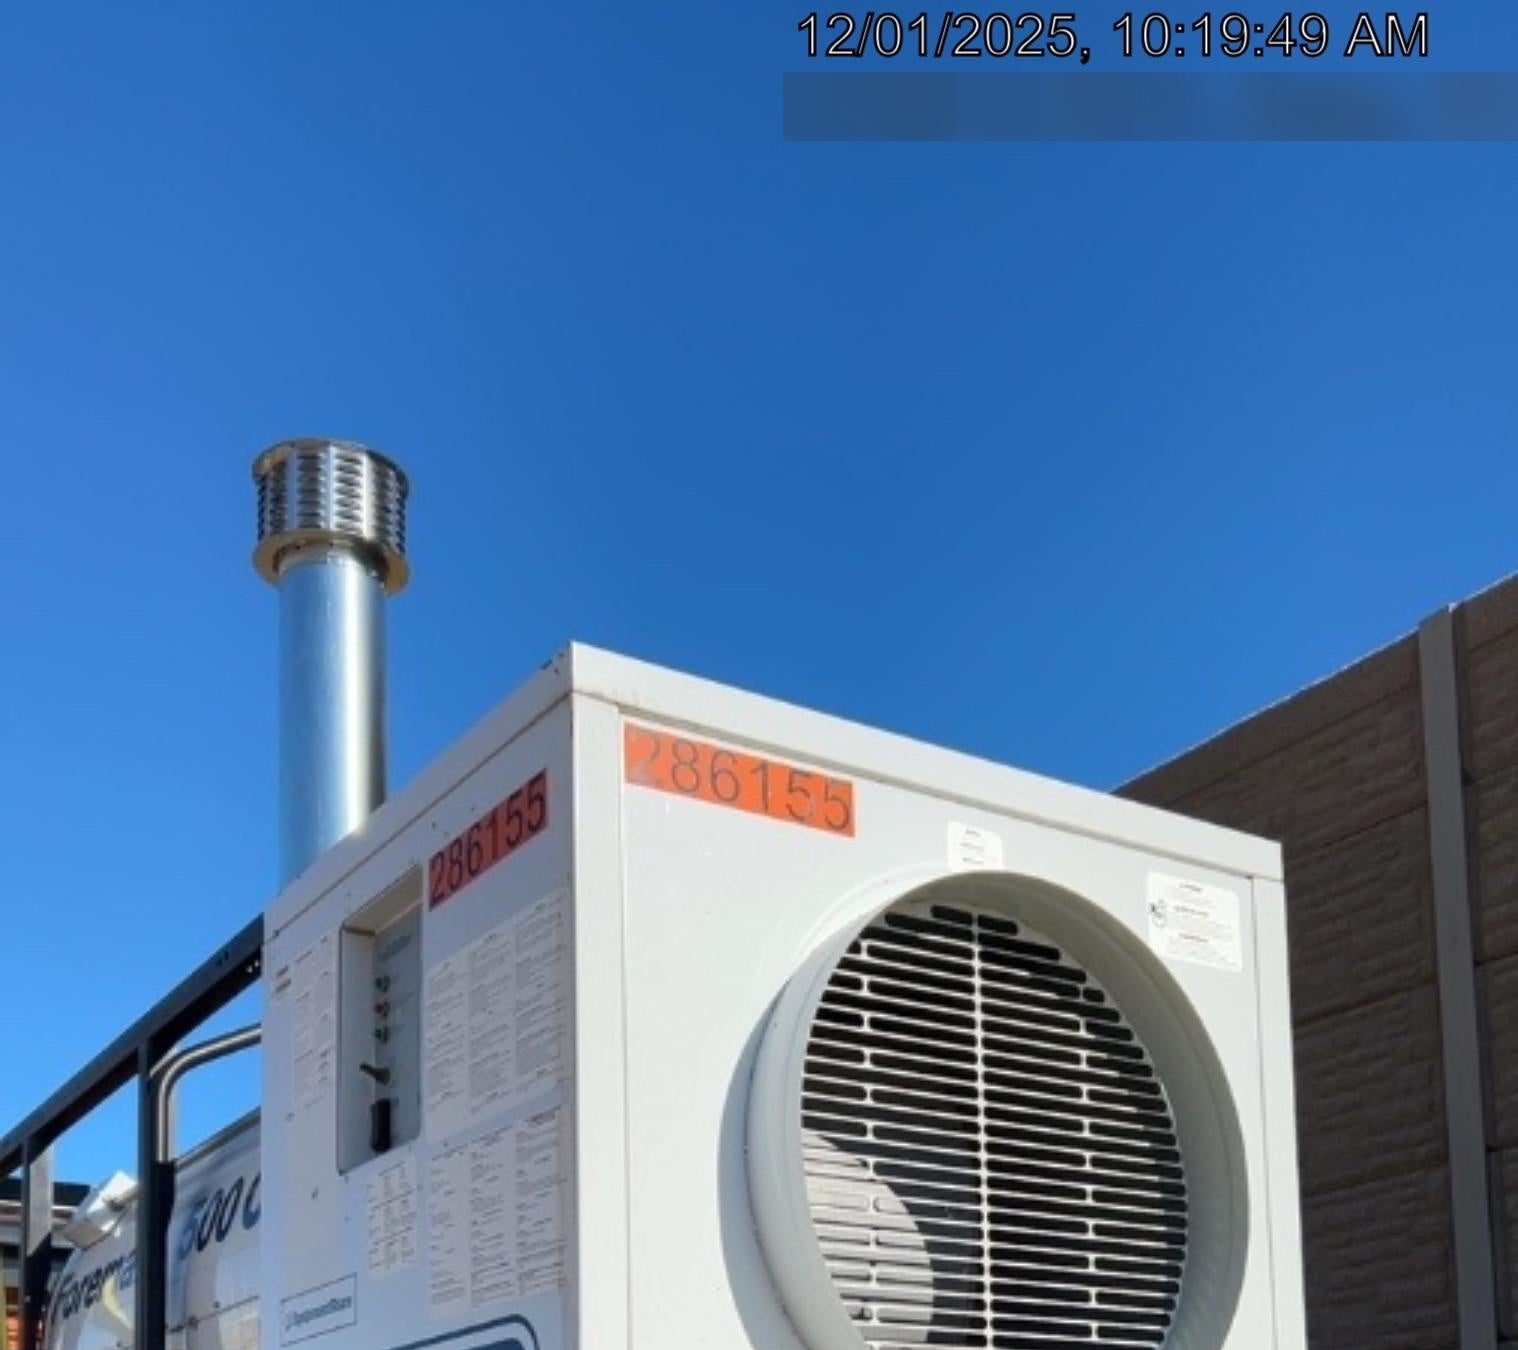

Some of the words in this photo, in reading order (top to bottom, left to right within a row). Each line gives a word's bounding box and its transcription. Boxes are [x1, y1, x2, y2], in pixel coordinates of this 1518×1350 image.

[626, 727, 850, 831] 286155
[430, 771, 547, 905] 286155
[51, 1249, 137, 1326] Forema
